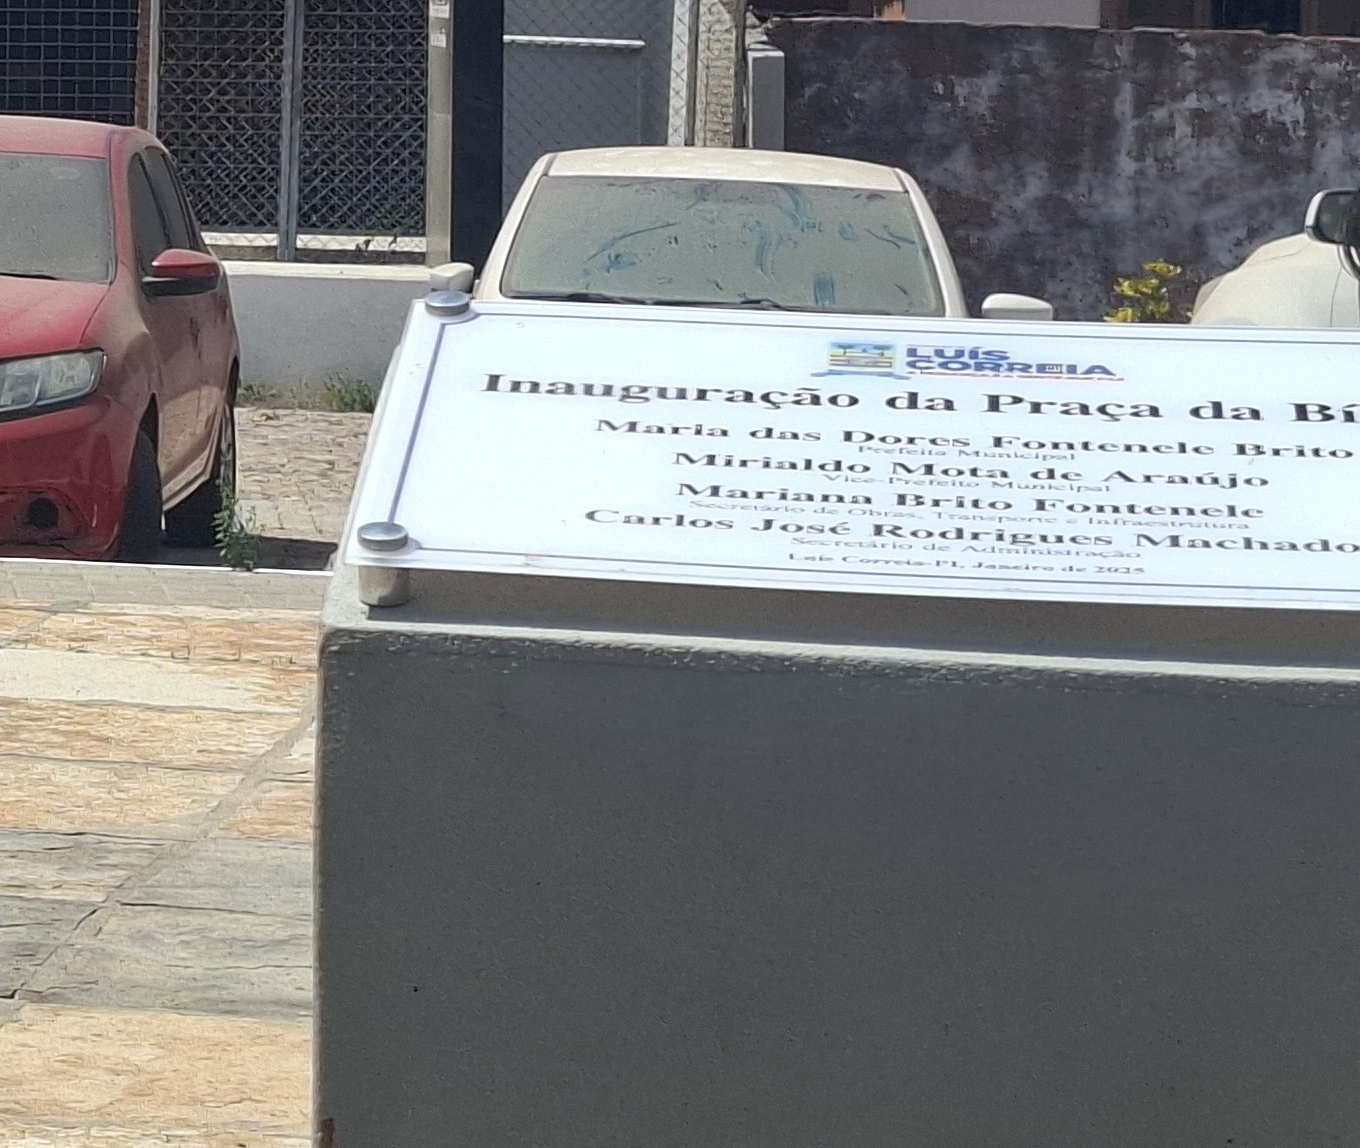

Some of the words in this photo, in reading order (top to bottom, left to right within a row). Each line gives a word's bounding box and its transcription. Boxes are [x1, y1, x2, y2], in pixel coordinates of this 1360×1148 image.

[905, 345, 1011, 362] LUÍS
[481, 372, 861, 410] Inauguração
[885, 391, 958, 413] da
[981, 393, 1164, 423] Praça
[1189, 400, 1262, 422] da
[594, 418, 730, 438] Maria
[749, 426, 822, 443] das
[841, 429, 971, 449] Dores
[991, 435, 1215, 456] Fontenele
[1233, 442, 1354, 459] Brito
[672, 451, 872, 475] Mirialdo
[889, 462, 1011, 481] Mota
[1030, 467, 1084, 483] de
[1101, 469, 1270, 489] Araújo
[675, 482, 873, 505] Mariana
[893, 492, 1014, 512] Brito
[1032, 497, 1265, 519] Fontenele
[584, 508, 735, 530] Carlos
[750, 518, 852, 536] José
[872, 522, 1114, 546] Rodrigues
[1136, 533, 1360, 554] Machado
